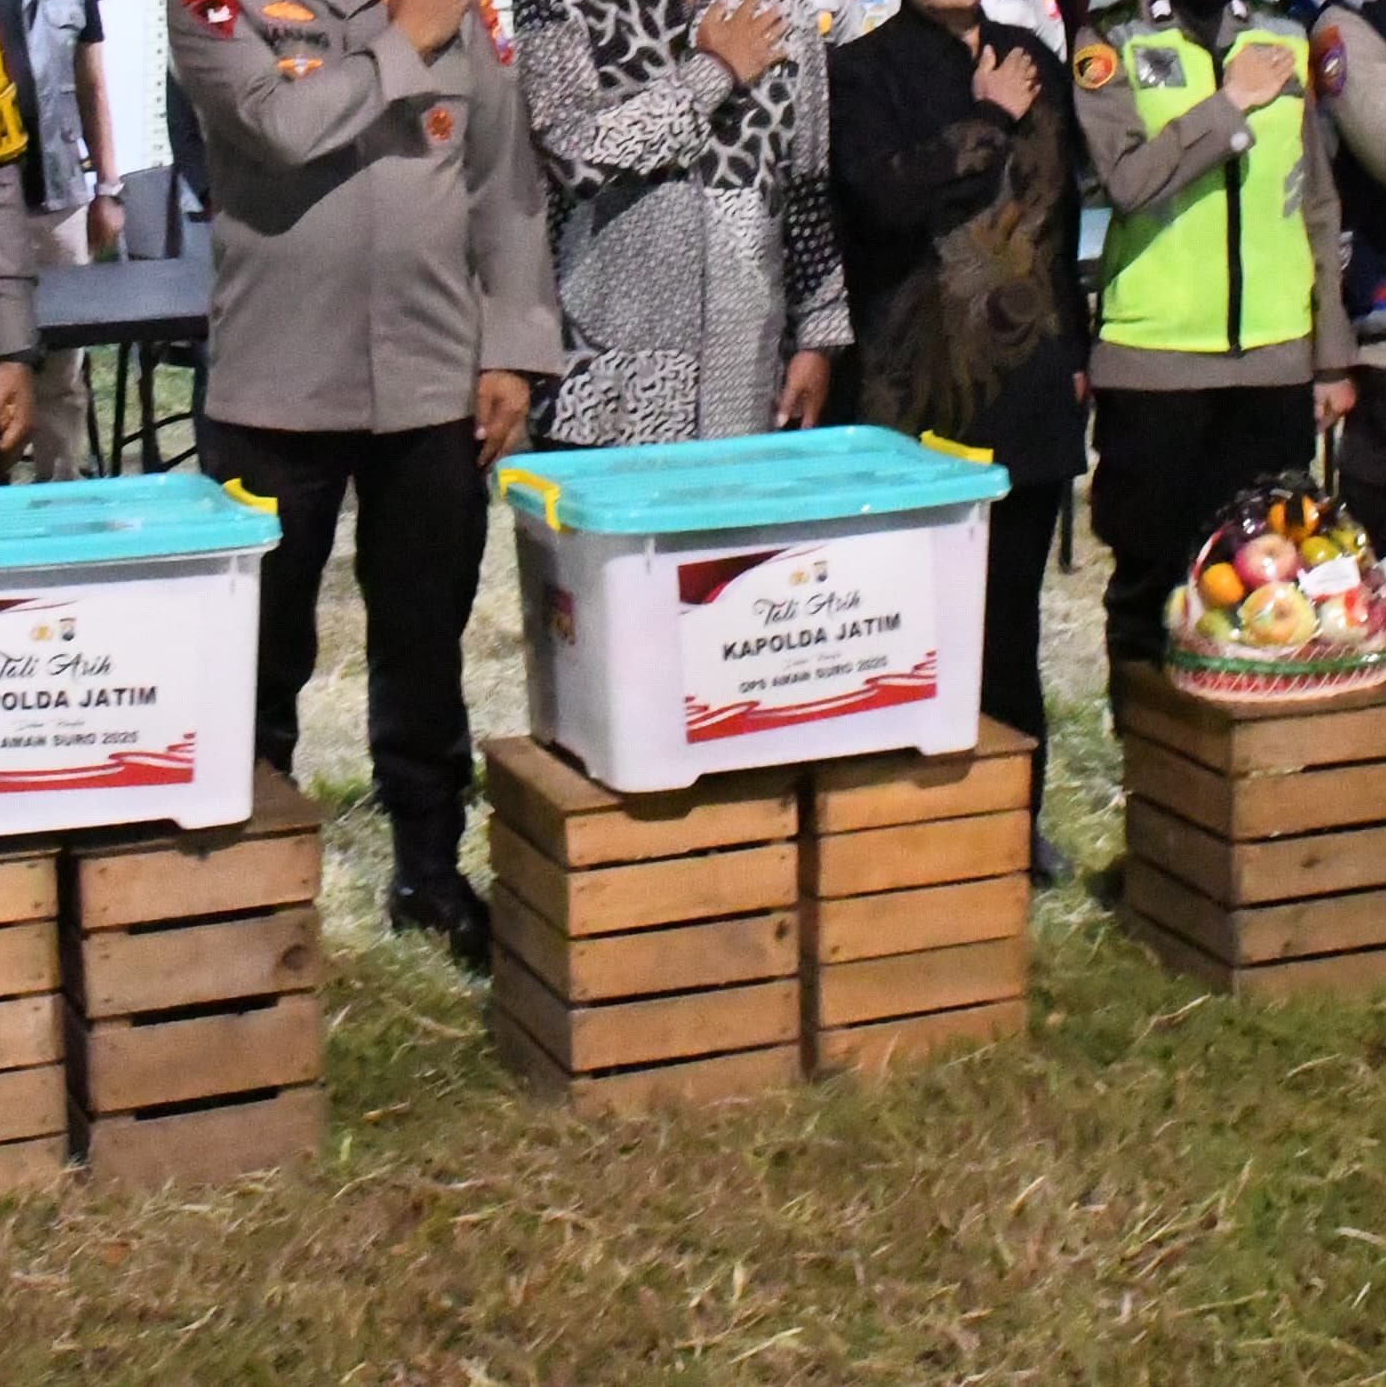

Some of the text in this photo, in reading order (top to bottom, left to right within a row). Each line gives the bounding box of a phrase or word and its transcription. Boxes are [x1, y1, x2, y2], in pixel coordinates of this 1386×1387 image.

[722, 627, 829, 662] KAPOLDA
[836, 612, 902, 642] JATIM
[79, 685, 158, 708] JATIM
